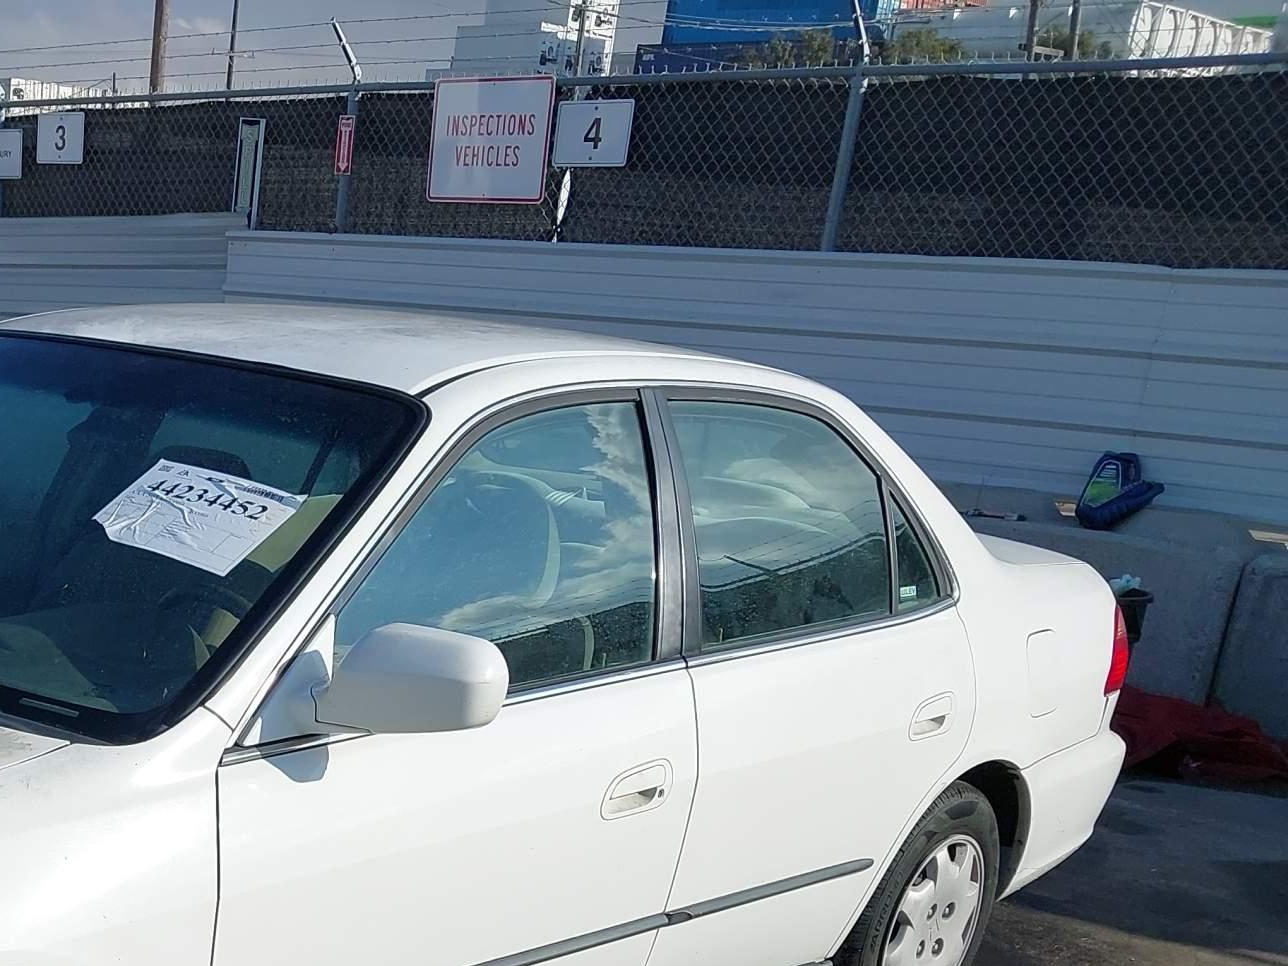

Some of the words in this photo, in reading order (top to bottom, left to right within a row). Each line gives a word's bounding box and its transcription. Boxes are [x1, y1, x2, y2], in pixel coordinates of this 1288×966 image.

[54, 125, 66, 151] 3
[446, 113, 537, 137] INSPECTIONS
[583, 117, 602, 150] 4
[455, 145, 521, 167] VEHICLES
[147, 479, 269, 521] 44234452
